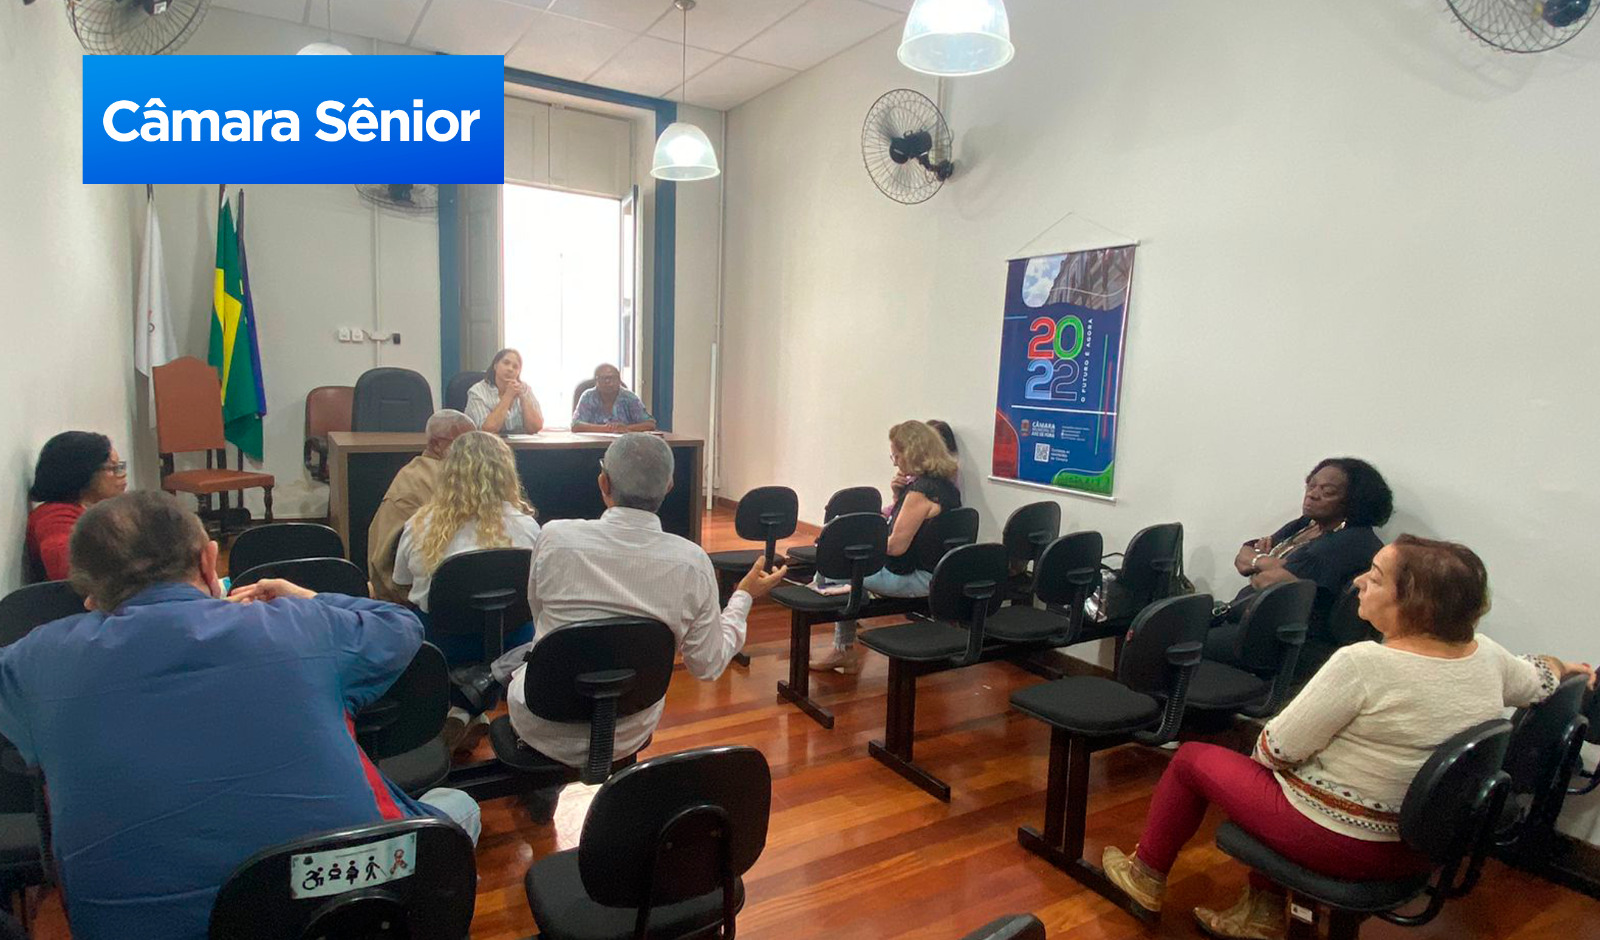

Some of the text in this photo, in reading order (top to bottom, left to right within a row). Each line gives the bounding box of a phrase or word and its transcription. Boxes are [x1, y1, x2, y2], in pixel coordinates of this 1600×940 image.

[1028, 315, 1084, 359] 20
[1025, 358, 1080, 401] 22
[1081, 360, 1089, 393] FUTURO
[1032, 420, 1055, 429] CÂMARA
